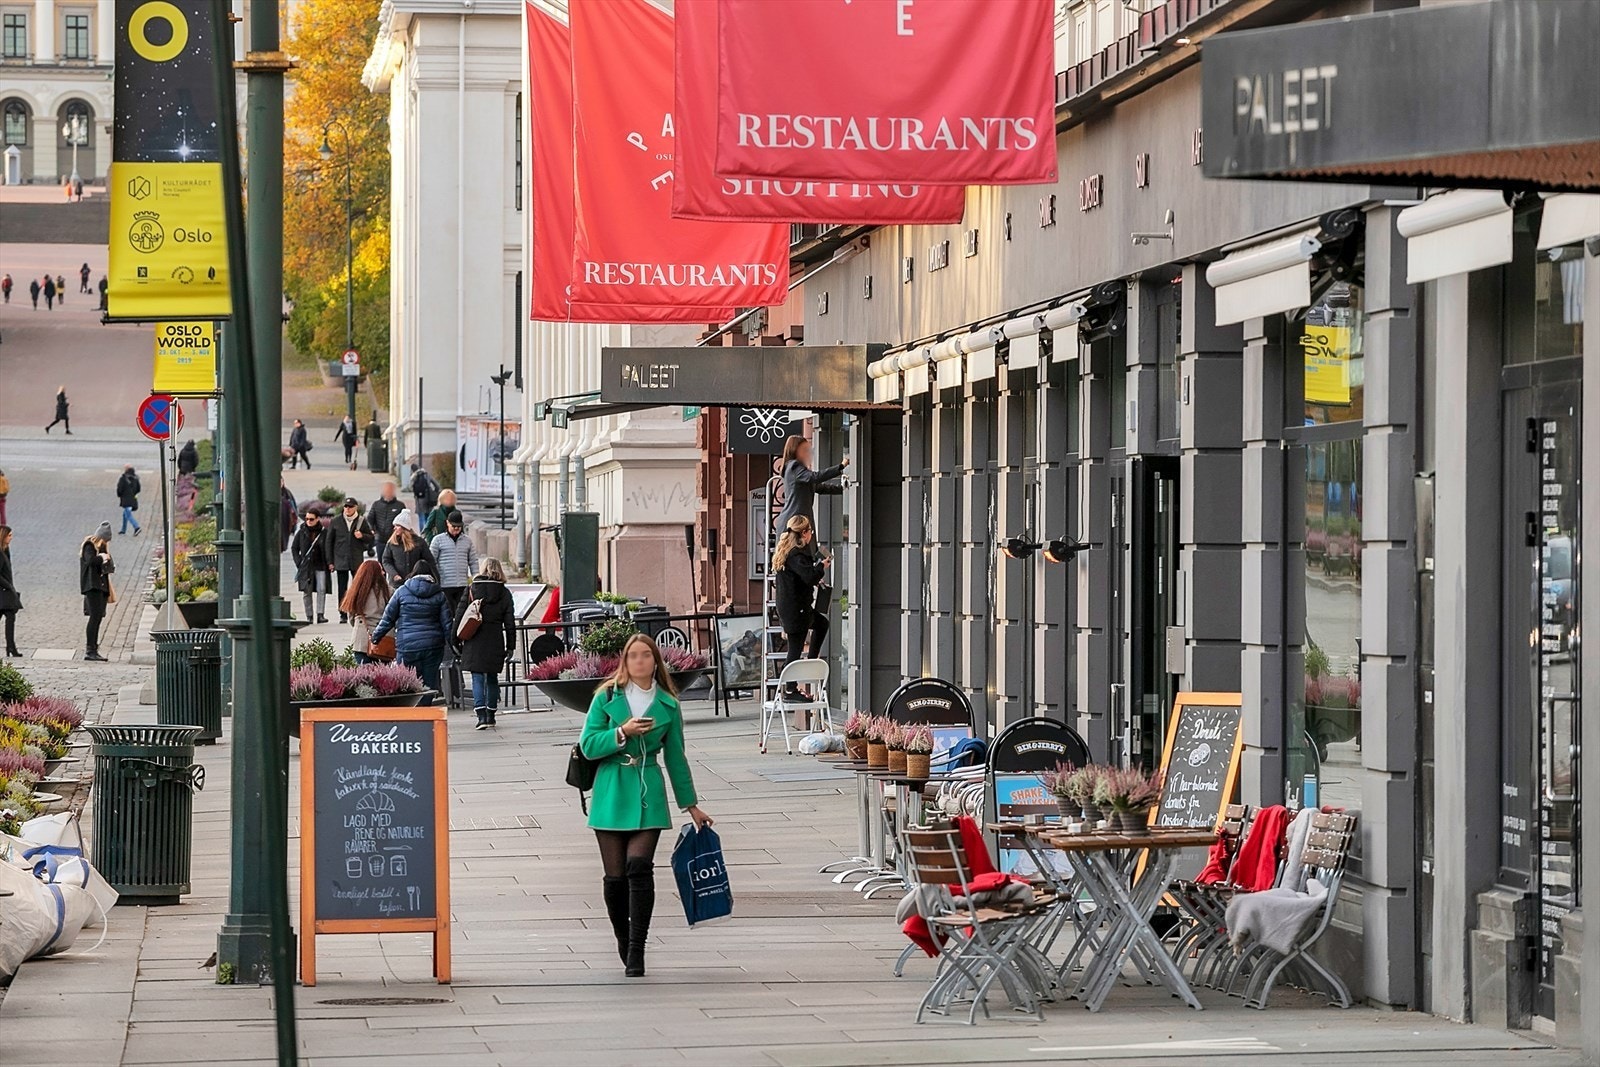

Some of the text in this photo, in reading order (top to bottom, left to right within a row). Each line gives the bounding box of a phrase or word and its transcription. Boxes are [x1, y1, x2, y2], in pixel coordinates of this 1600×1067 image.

[1233, 65, 1338, 135] PALEET
[737, 113, 1038, 151] RESTAURANTS
[173, 227, 212, 243] Oslo
[583, 261, 777, 287] RESTAURANTS
[166, 325, 202, 336] OSLO
[157, 337, 211, 348] WORLD
[621, 364, 680, 388] PALEET
[329, 724, 398, 743] United
[351, 742, 421, 754] BAKERIES
[1011, 787, 1043, 801] SHAKE
[344, 813, 392, 827] LAGD MED
[354, 826, 425, 840] RENE OG NATURLIGE
